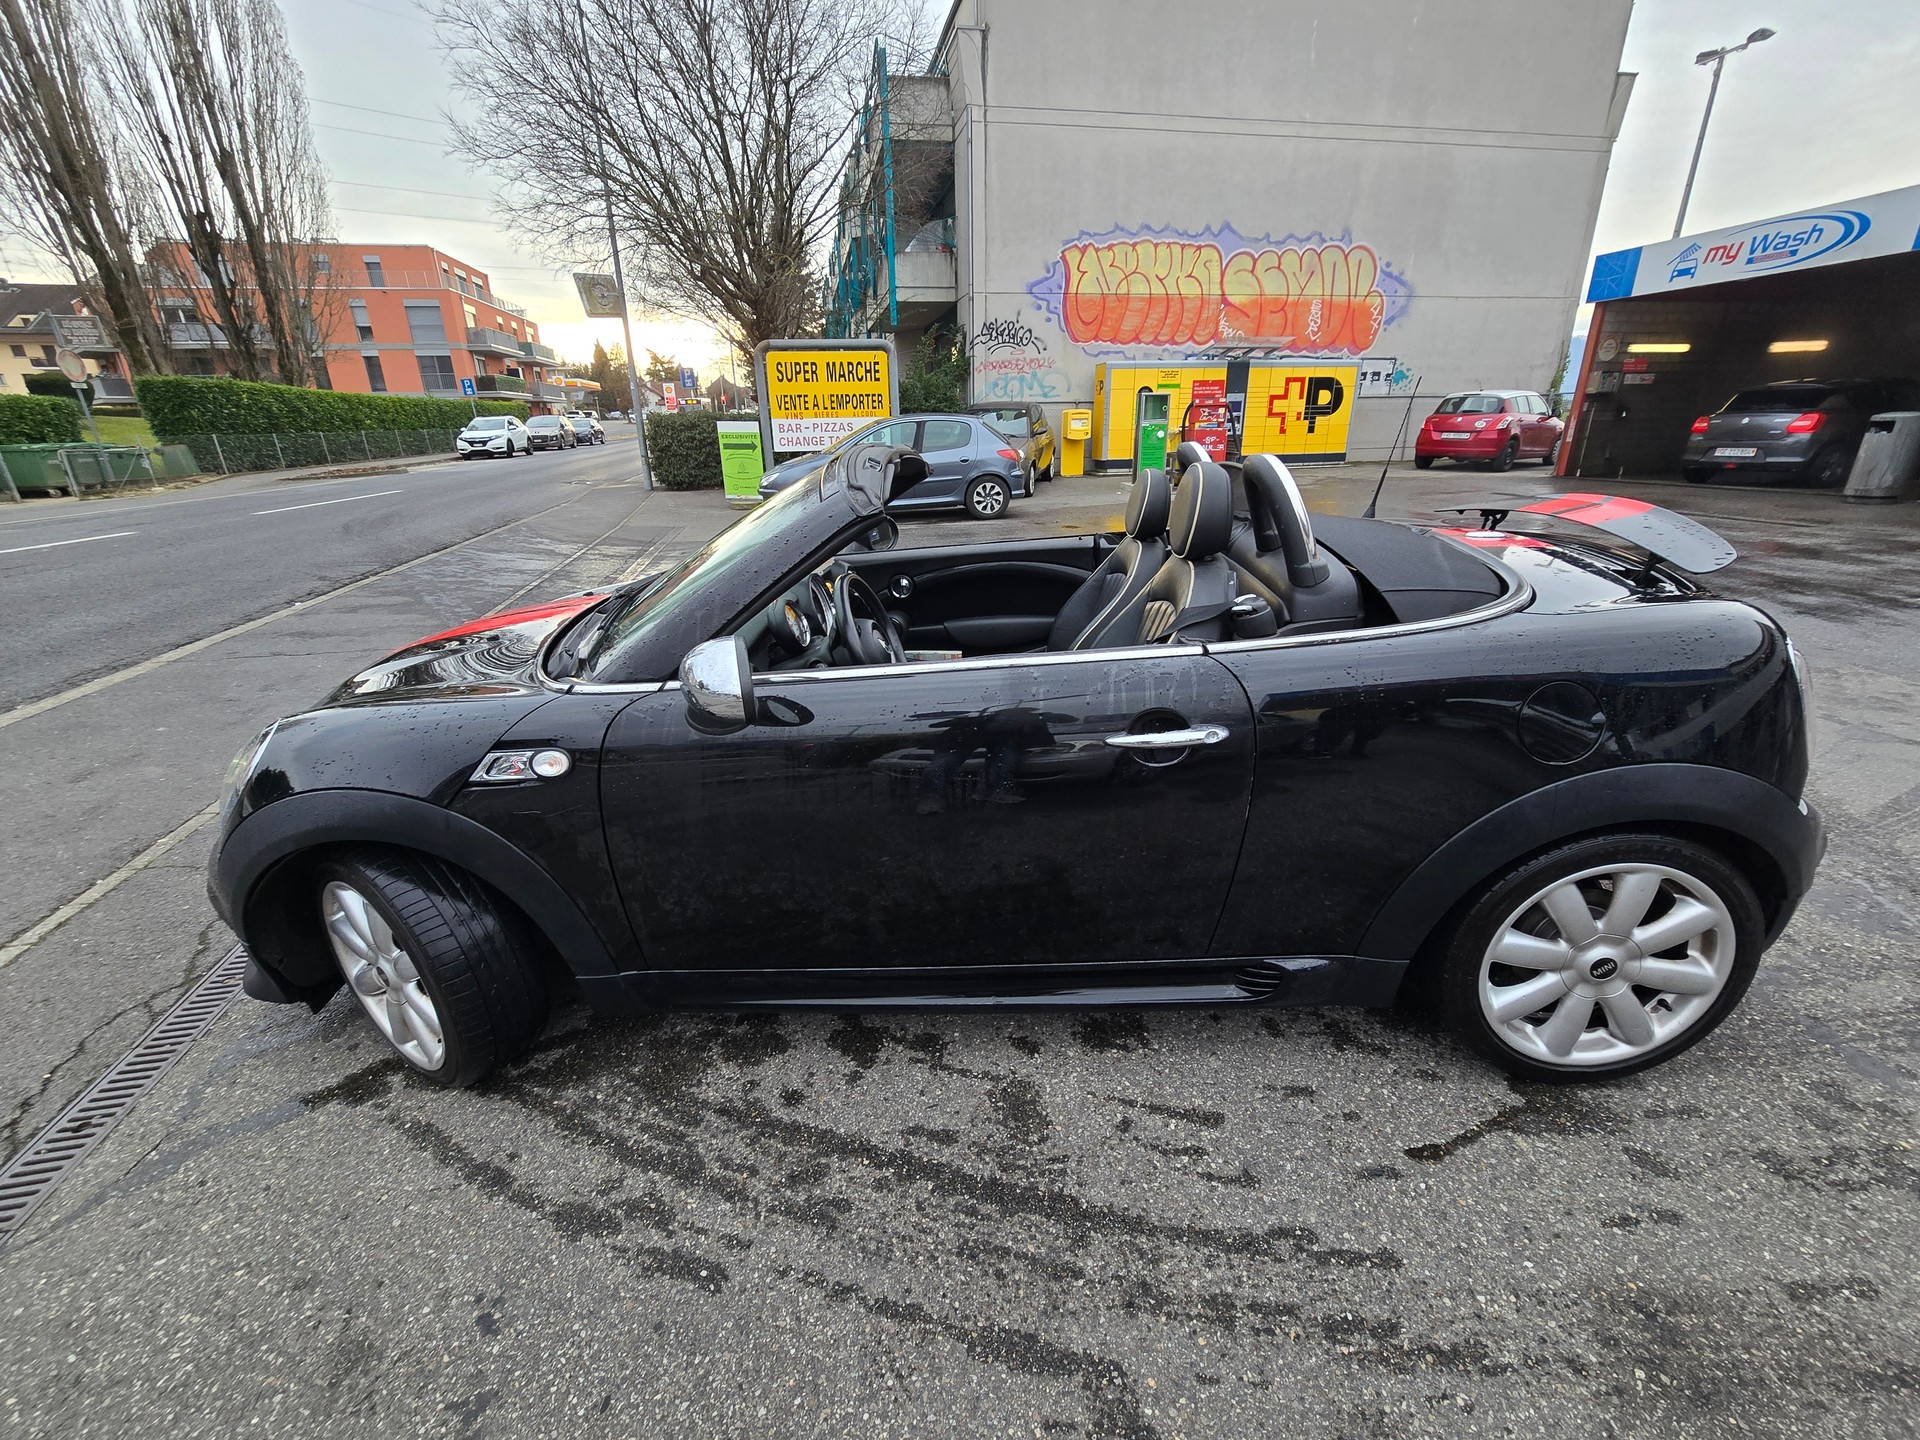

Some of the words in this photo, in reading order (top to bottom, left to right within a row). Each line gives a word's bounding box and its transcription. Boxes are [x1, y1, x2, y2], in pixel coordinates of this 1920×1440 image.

[1702, 241, 1745, 265] my
[1749, 223, 1824, 256] Wash
[684, 369, 691, 379] P
[775, 361, 819, 382] SUPER
[826, 354, 880, 382] MARCHÉ
[775, 394, 809, 411] VENTE
[812, 394, 820, 410] A
[822, 393, 884, 410] L'EMPORTER
[784, 412, 804, 420] VINS
[779, 436, 825, 446] CHANGE
[1592, 961, 1616, 977] MINI
